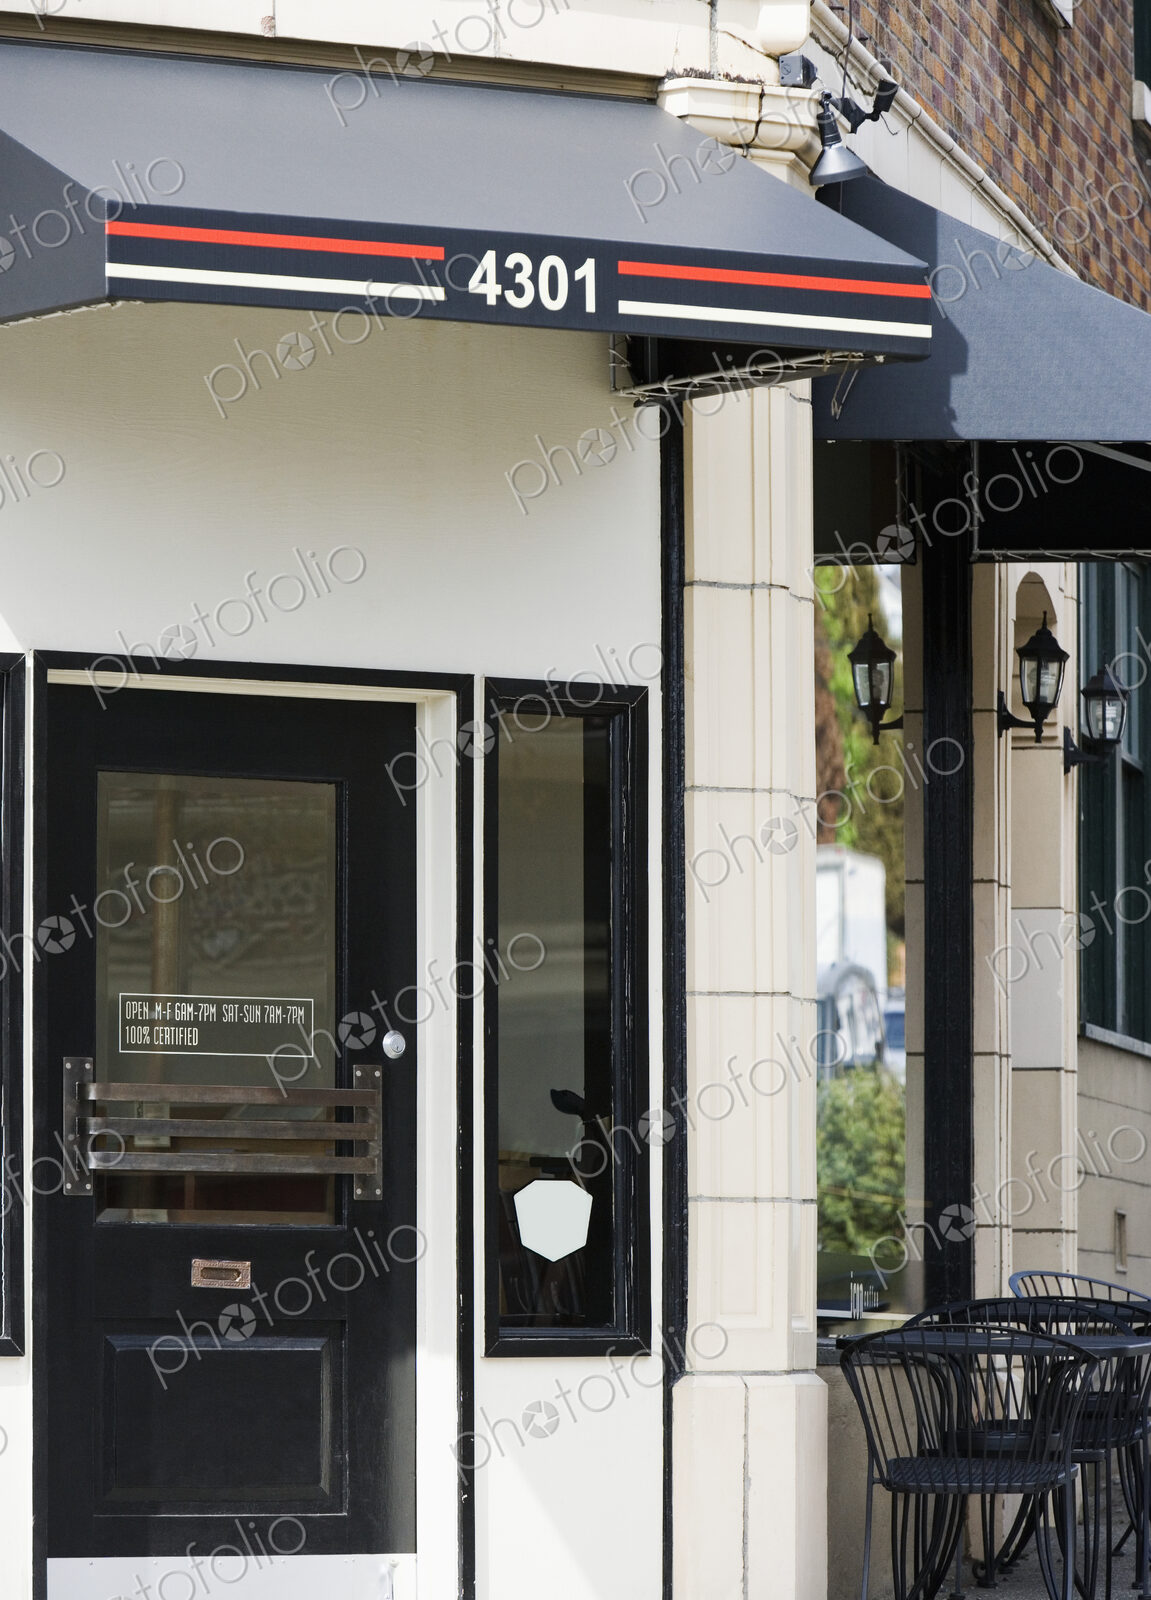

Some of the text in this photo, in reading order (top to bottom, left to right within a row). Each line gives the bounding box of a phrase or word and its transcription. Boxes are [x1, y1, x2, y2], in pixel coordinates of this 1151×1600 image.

[468, 250, 596, 313] 4301
[125, 1001, 305, 1025] OPEN M-F 6AM-7PM SAT-SUN 7AM-7PM
[125, 1025, 199, 1046] 100% CERTIFIED
